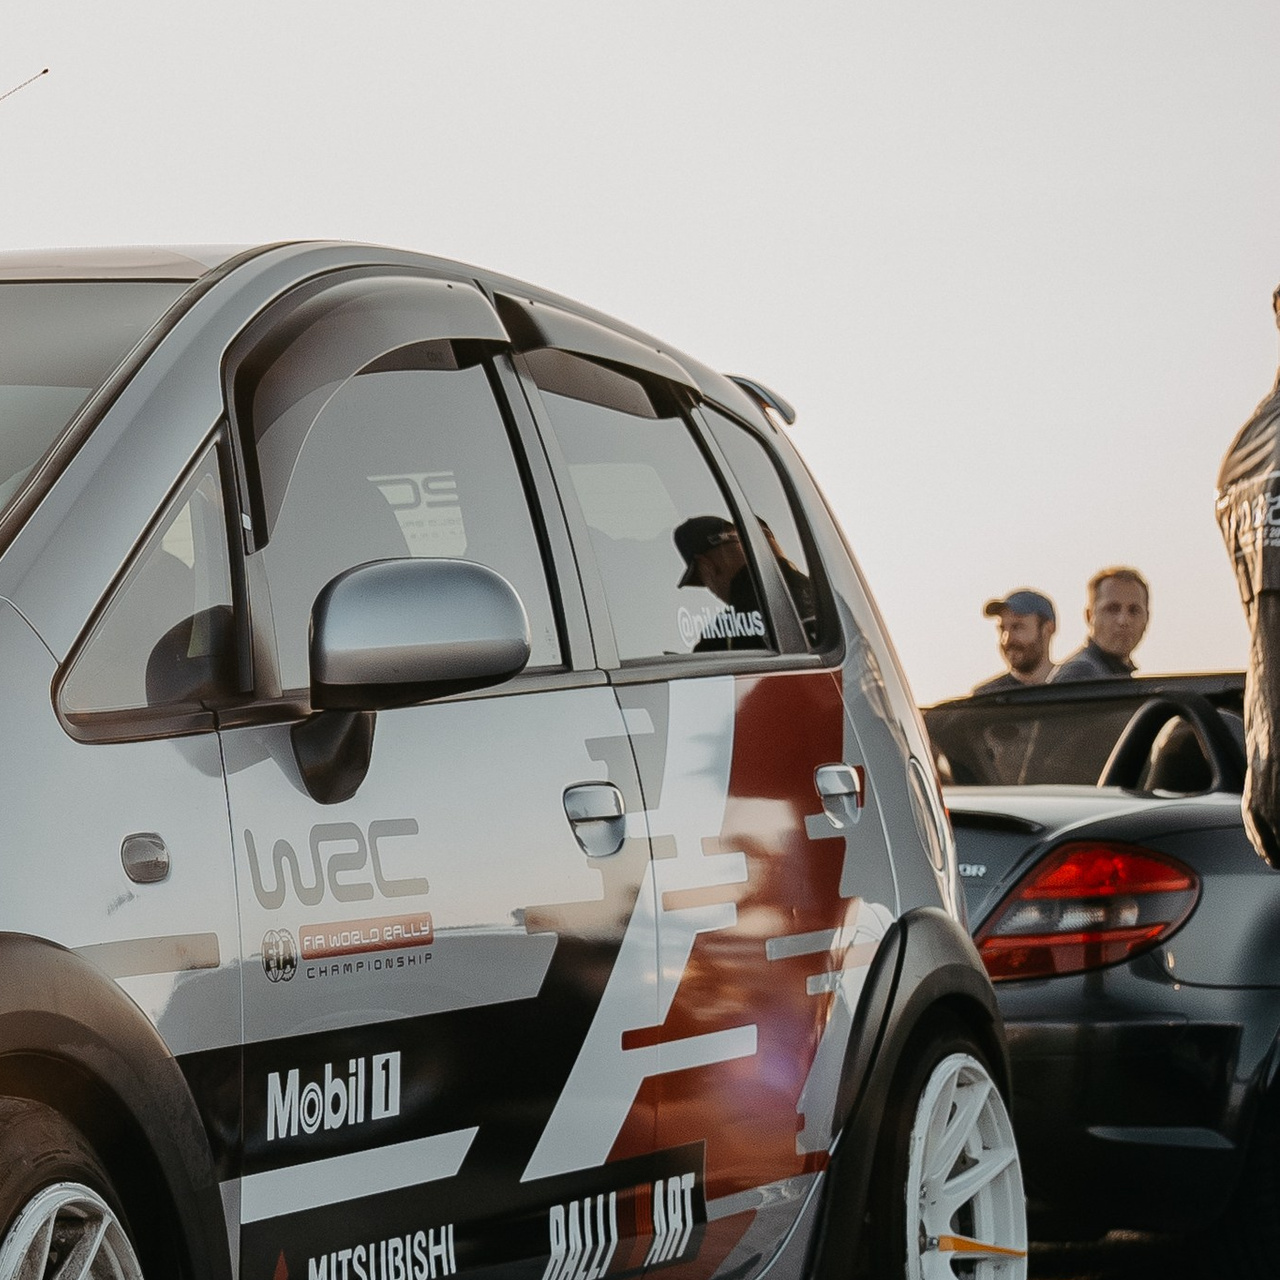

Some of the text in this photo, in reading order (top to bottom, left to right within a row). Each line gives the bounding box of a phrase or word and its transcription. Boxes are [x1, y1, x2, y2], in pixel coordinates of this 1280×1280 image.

[678, 605, 766, 648] @nikitikus
[244, 818, 430, 910] WRC
[303, 920, 430, 951] FIA WORLD RALLY
[306, 952, 433, 979] CHAMPIONSHIP
[267, 1057, 365, 1141] Mobil
[644, 1172, 695, 1267] ART
